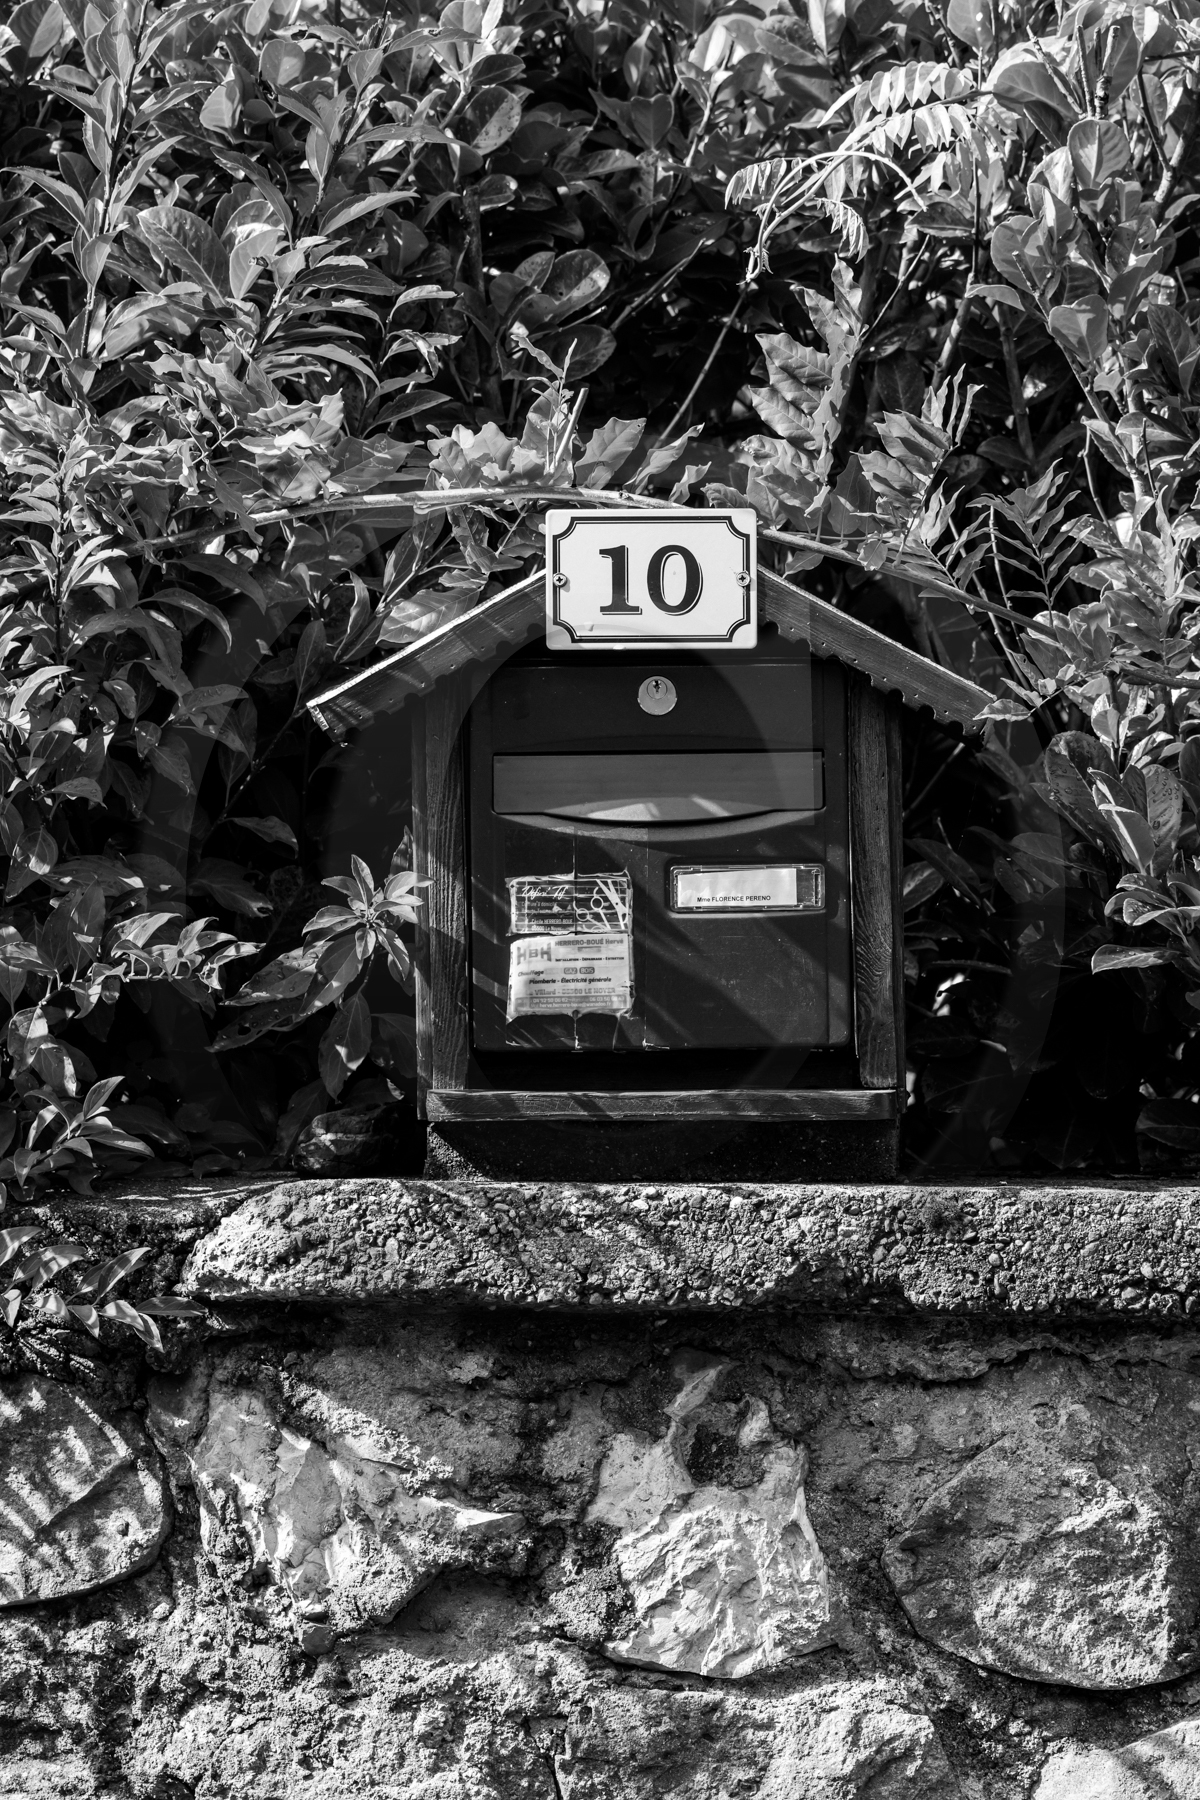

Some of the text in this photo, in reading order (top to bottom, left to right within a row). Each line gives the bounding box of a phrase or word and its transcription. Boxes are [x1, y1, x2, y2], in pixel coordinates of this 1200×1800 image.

[599, 545, 704, 616] 10
[517, 942, 552, 965] HBH
[554, 938, 604, 947] HERRERO-BOUÉ
